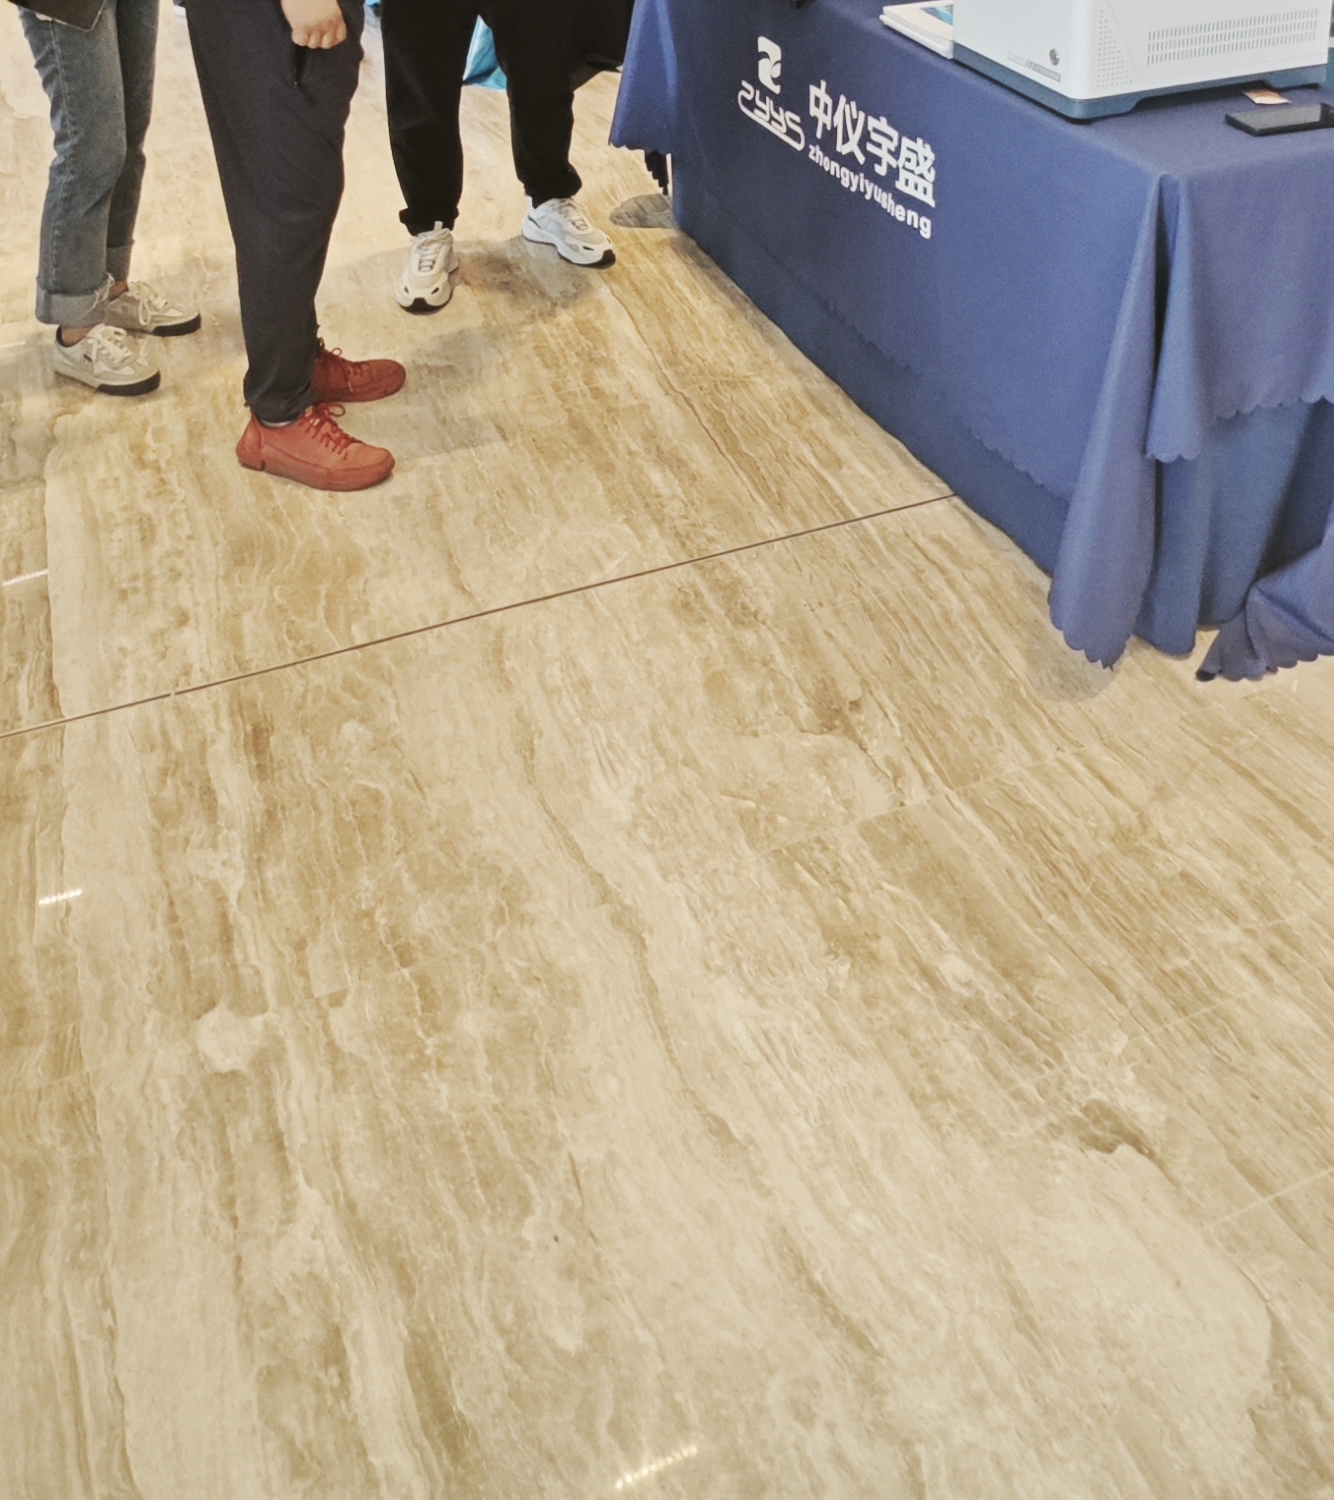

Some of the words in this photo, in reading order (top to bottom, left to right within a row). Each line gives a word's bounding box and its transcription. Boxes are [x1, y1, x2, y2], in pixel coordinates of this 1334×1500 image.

[808, 80, 936, 208] 中仪宇盛
[808, 144, 932, 240] zhongyiyusheng
